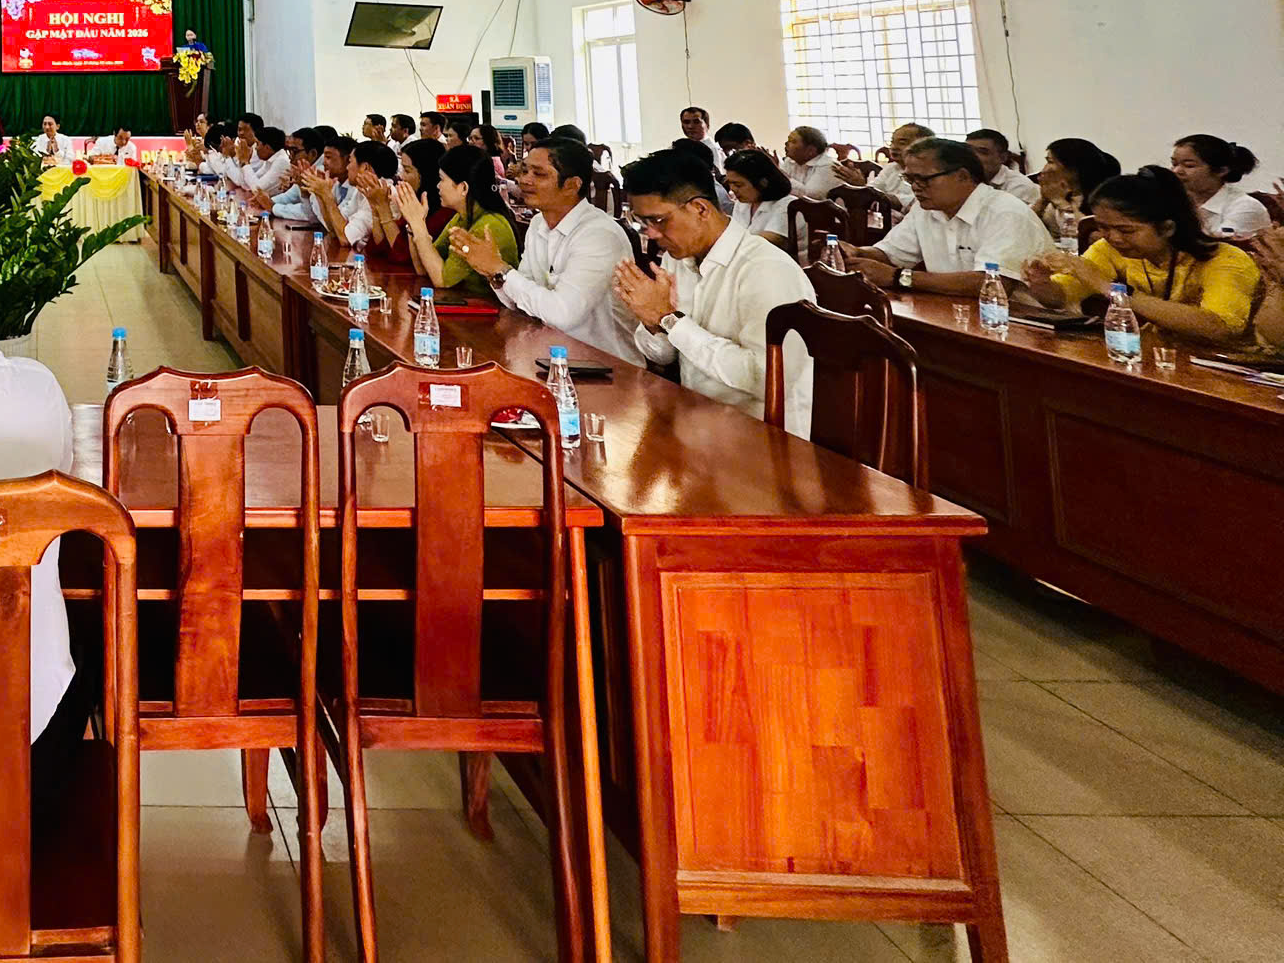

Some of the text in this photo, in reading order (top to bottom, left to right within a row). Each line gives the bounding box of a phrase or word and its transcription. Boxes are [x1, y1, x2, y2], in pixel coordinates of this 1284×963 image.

[49, 12, 124, 27] HỘI NGHỊ
[26, 29, 48, 40] GẶP
[50, 29, 74, 39] MẶT
[100, 29, 125, 37] NĂM
[128, 29, 148, 37] 2026
